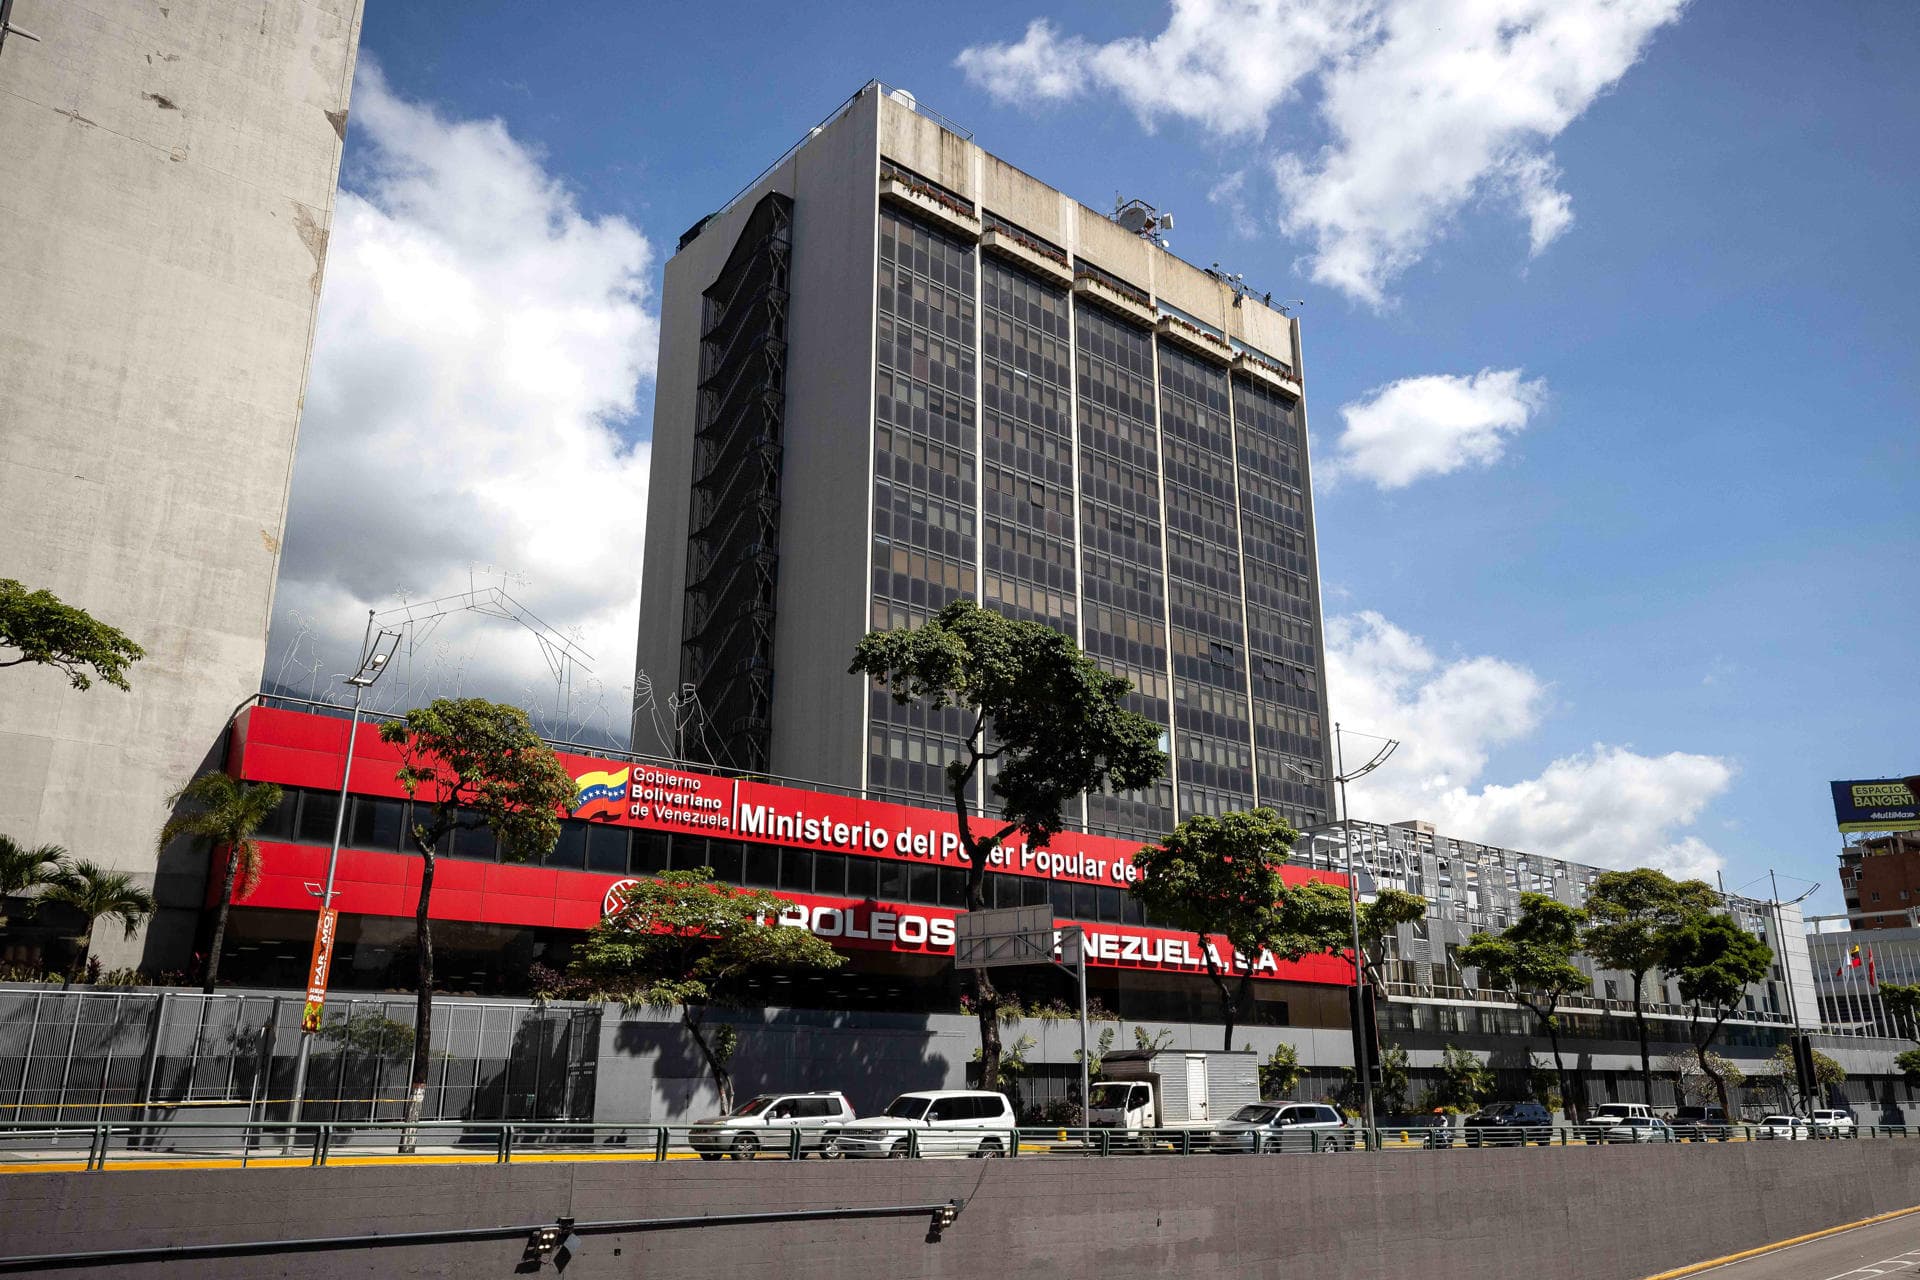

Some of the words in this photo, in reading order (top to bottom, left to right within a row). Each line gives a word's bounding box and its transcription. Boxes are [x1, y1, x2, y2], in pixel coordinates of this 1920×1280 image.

[633, 767, 701, 790] Gobierno
[1855, 785, 1908, 795] ESPACIOS
[631, 784, 722, 809] Bolivariano
[630, 802, 649, 816] de
[654, 804, 729, 827] Venezuela
[740, 803, 889, 849] Ministerio
[896, 826, 935, 856] del
[942, 832, 1014, 865] Poer
[1111, 857, 1137, 881] de
